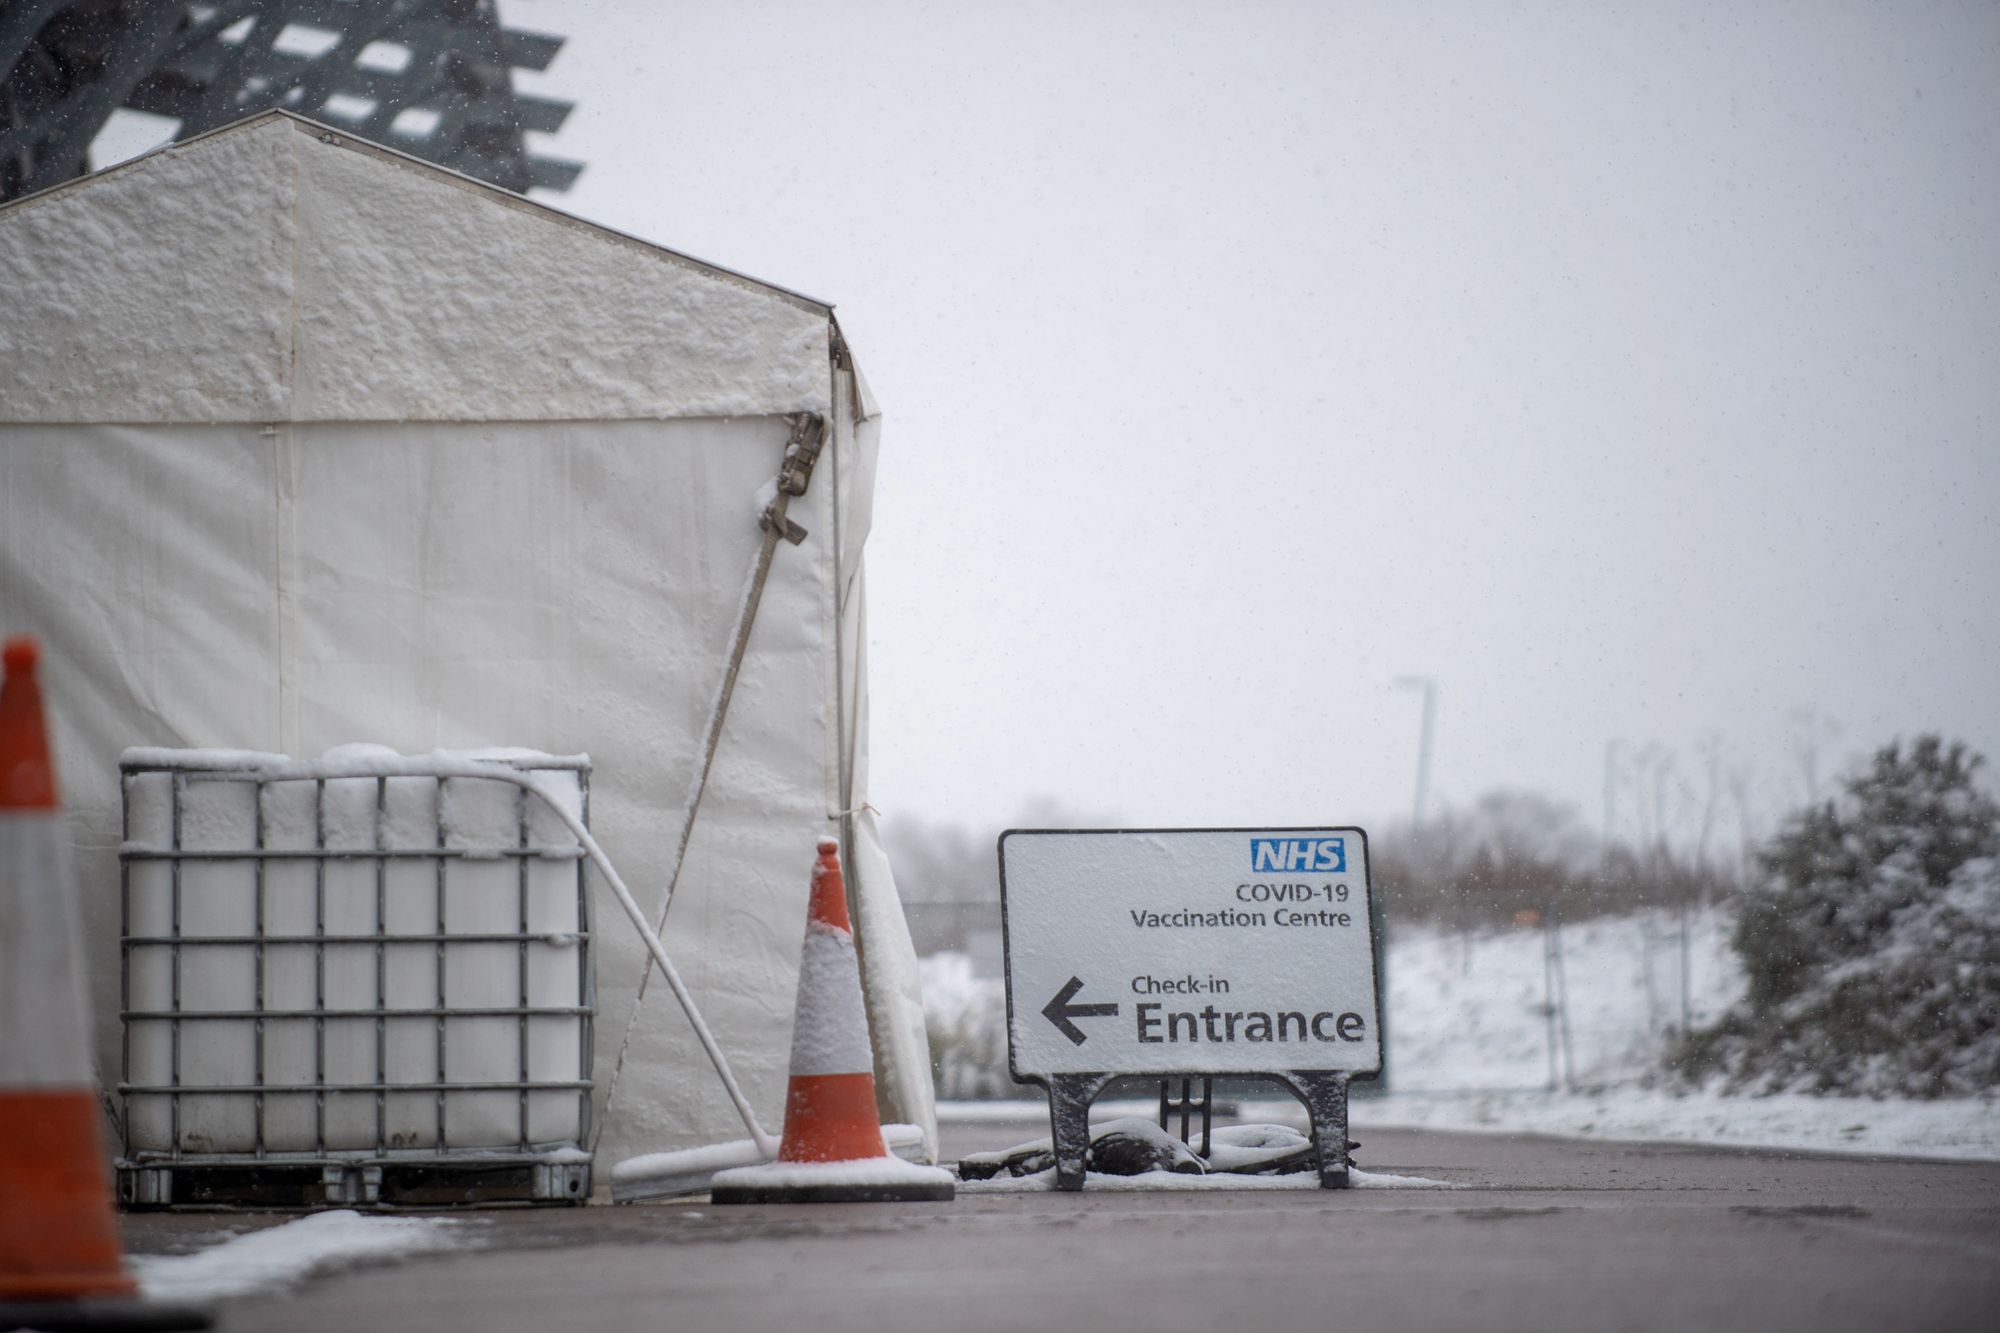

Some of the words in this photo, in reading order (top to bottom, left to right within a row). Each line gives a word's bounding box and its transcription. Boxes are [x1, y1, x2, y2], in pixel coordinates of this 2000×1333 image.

[1254, 840, 1342, 871] NHS
[1235, 883, 1350, 902] COVID-19
[1130, 908, 1266, 928] Vaccination
[1273, 908, 1351, 927] Centre
[1131, 974, 1230, 995] Check-in
[1136, 1003, 1365, 1043] Entrance
